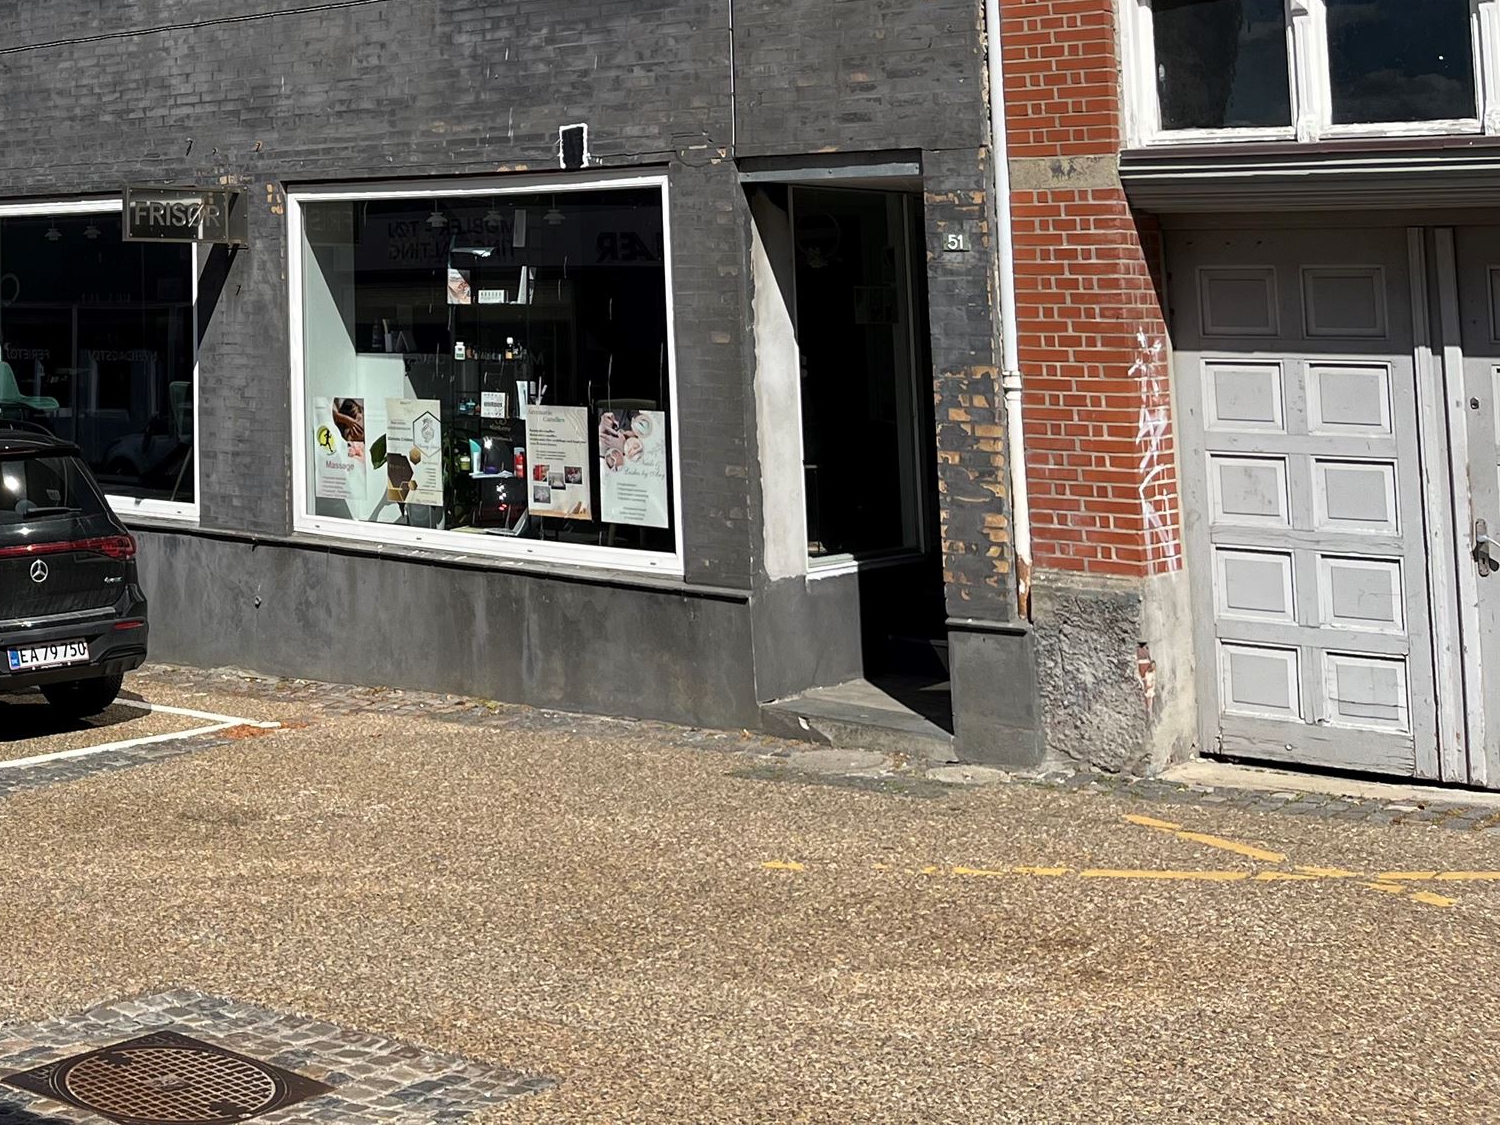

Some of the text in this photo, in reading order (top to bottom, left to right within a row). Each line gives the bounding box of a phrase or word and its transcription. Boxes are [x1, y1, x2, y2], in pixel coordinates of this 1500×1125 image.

[134, 201, 221, 228] FRISØR
[947, 234, 964, 250] 51
[325, 460, 355, 471] Massage
[19, 641, 86, 664] EA 79 750
